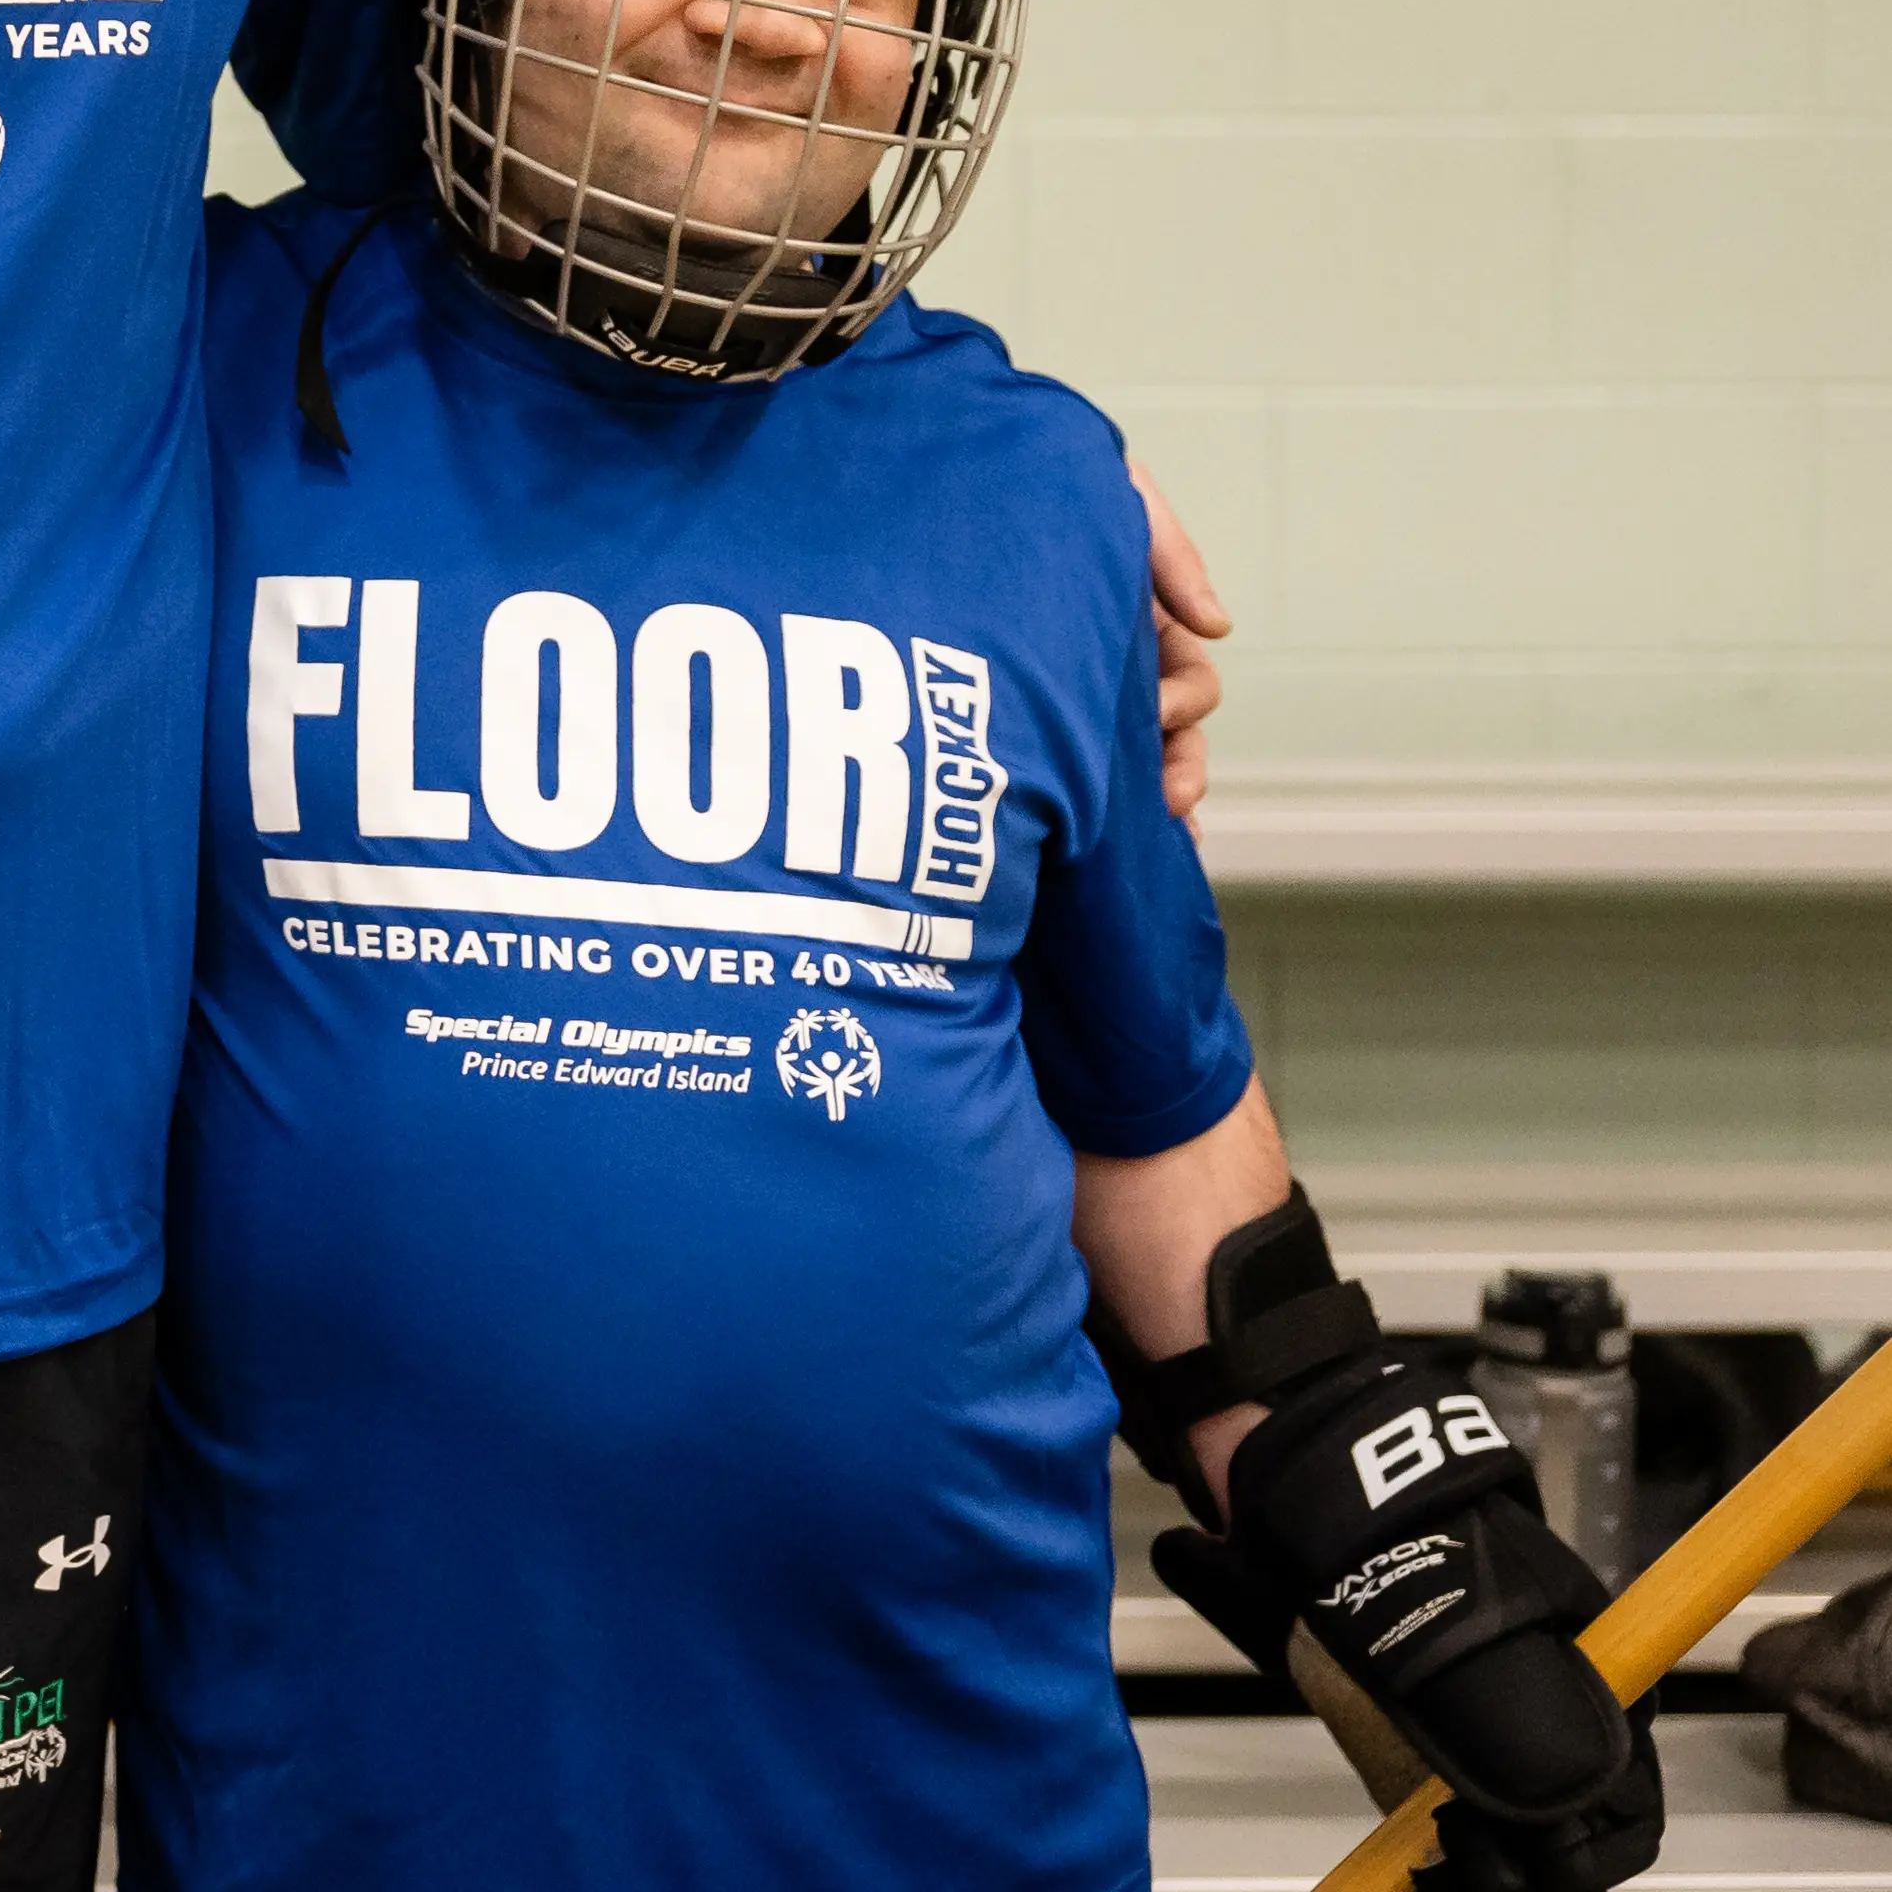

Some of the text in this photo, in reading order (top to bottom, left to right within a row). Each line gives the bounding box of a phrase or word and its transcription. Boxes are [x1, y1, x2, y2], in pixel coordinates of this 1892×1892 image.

[5, 19, 152, 59] YEARS
[247, 575, 912, 882] FLOOR
[922, 649, 994, 890] HOCKEY
[282, 917, 956, 993] CELEBRATING OVER 40 YEARS
[405, 1008, 752, 1061] Special Olympics
[462, 1051, 751, 1094] Prince Edward Island
[1315, 1534, 1466, 1607] VAPOR
[14, 1678, 64, 1736] PEI
